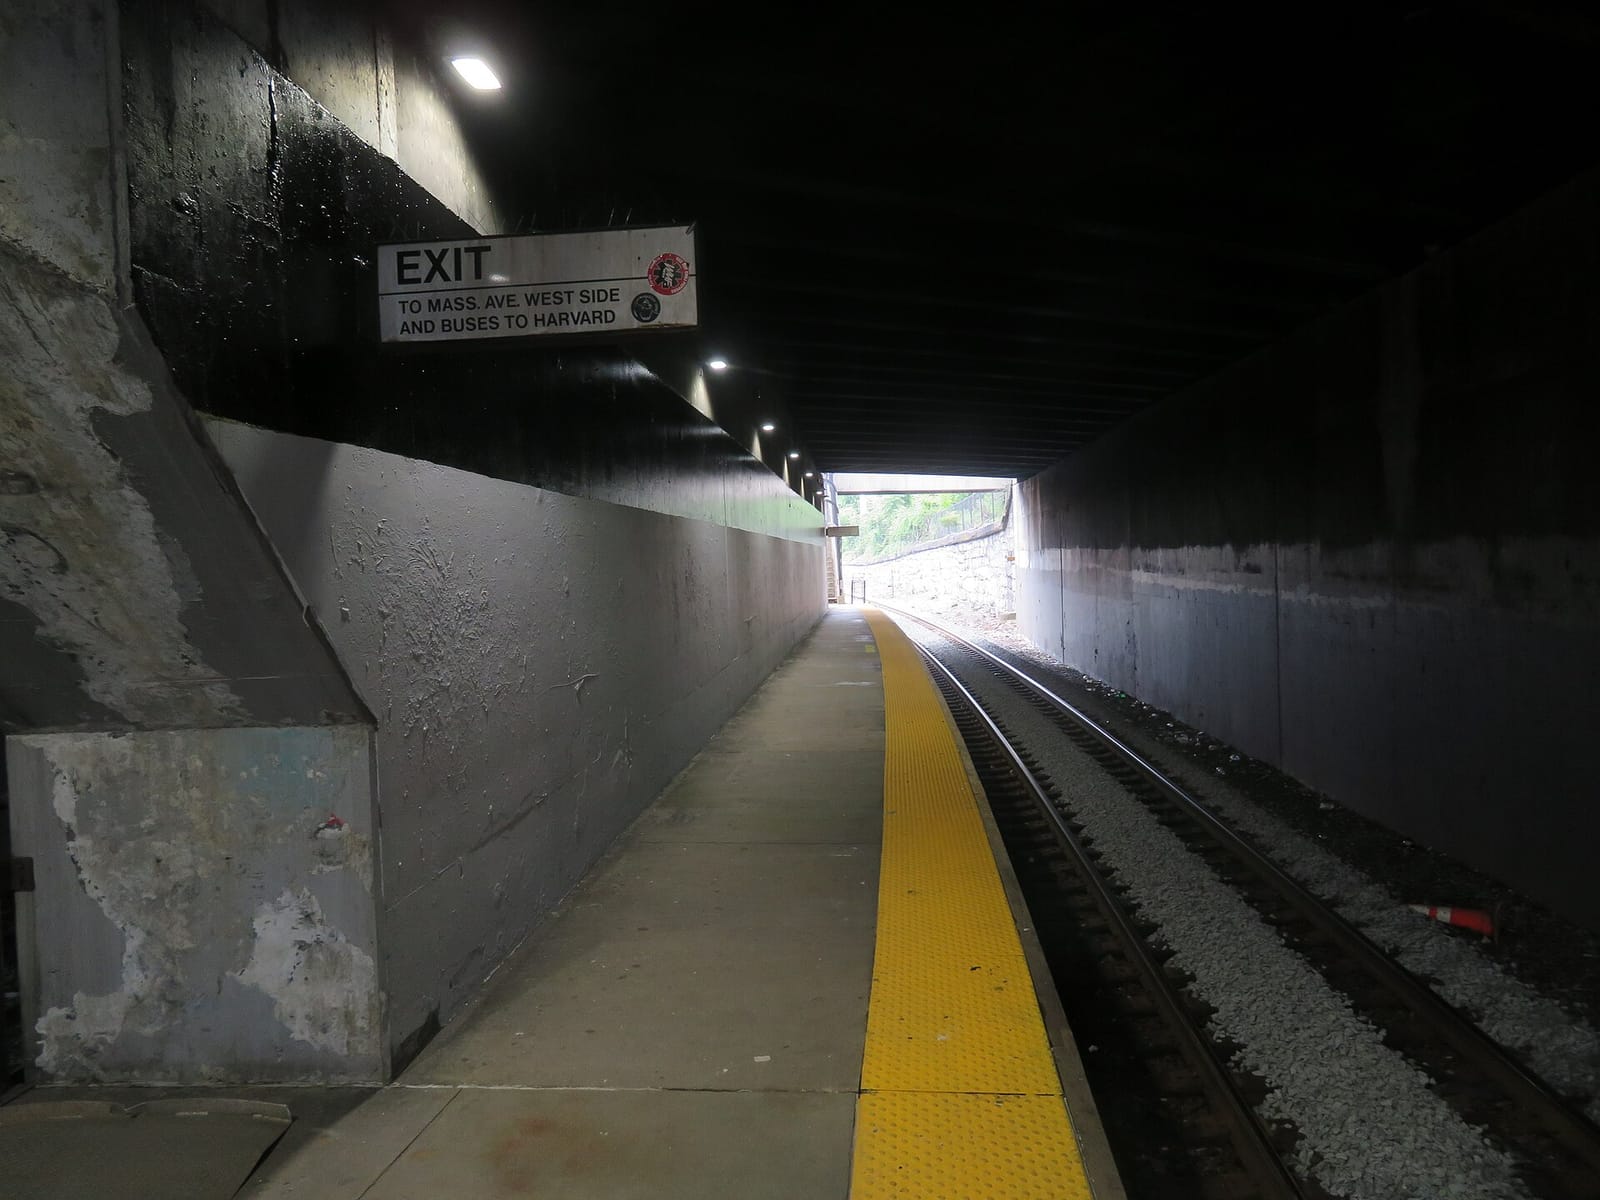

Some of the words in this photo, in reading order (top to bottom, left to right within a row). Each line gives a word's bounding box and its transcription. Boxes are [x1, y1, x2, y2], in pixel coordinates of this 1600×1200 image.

[396, 245, 491, 285] EXIT
[399, 299, 421, 314] TO
[428, 296, 481, 313] MASS.
[485, 293, 520, 309] AVE.
[525, 290, 575, 307] WEST
[581, 288, 620, 304] SIDE
[399, 319, 435, 335] AND
[441, 315, 500, 332] BUSES
[506, 313, 528, 329] TO
[534, 309, 616, 327] HARVARD
